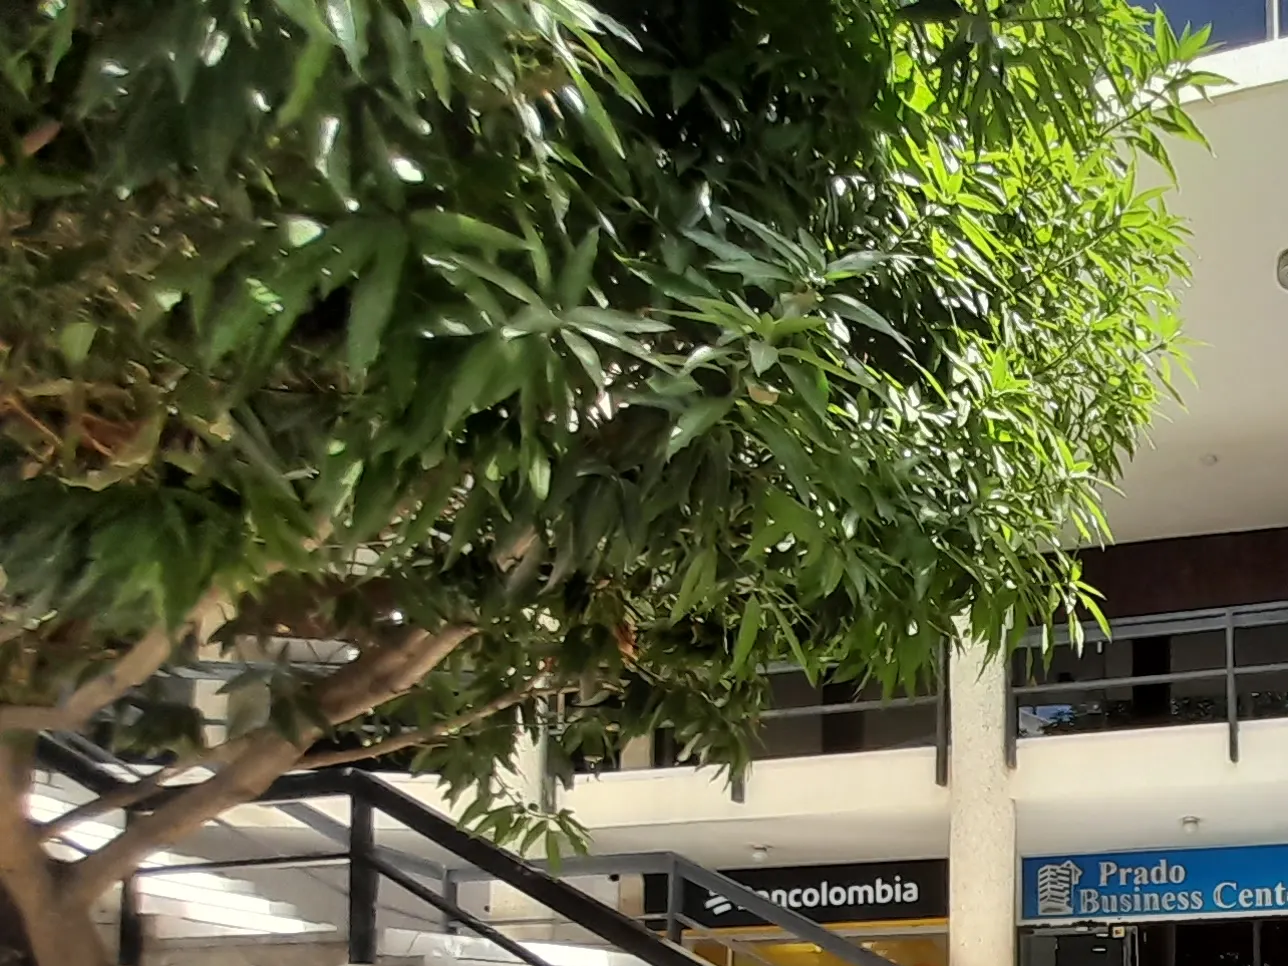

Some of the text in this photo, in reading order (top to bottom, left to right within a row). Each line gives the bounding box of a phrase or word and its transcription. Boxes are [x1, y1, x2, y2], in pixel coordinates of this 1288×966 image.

[1098, 859, 1186, 887] Prado
[738, 875, 919, 911] ncolombia
[1079, 886, 1203, 915] Business
